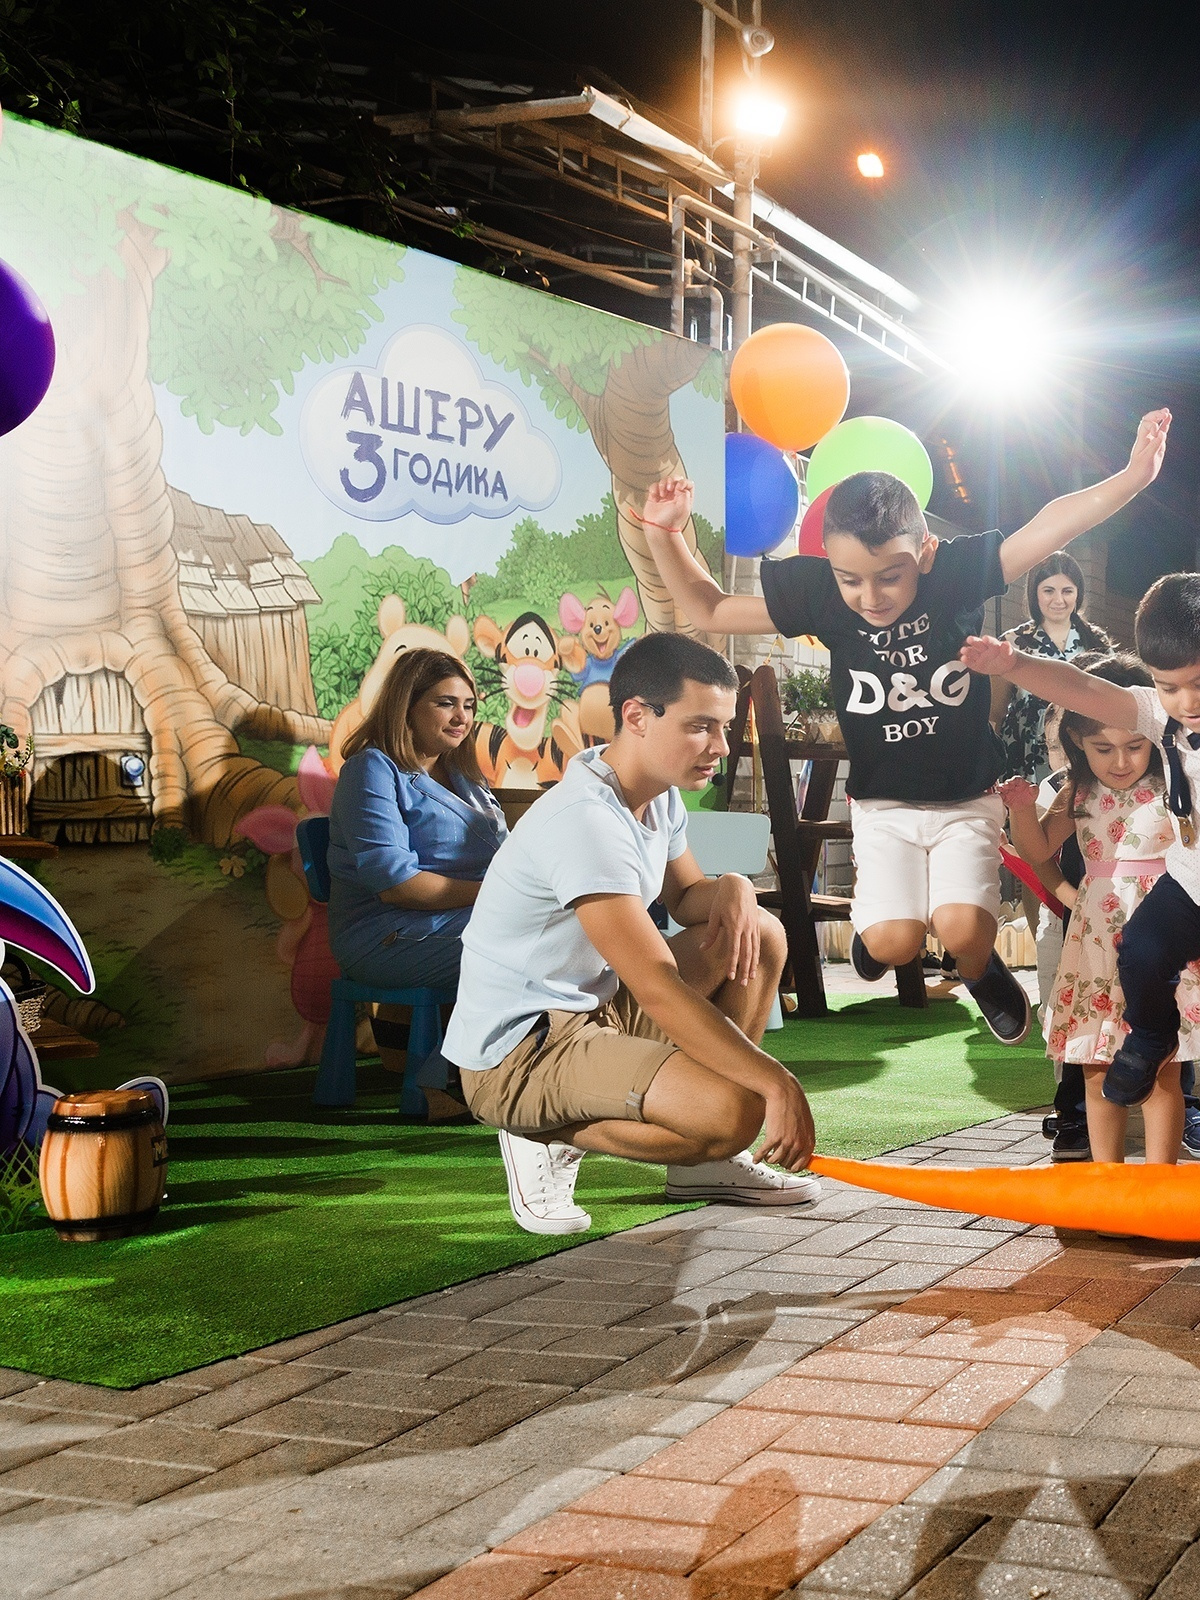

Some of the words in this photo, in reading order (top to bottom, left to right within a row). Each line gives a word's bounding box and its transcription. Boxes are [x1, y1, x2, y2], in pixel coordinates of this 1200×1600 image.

[341, 371, 515, 452] АШЕРУ
[339, 430, 387, 503] 3
[393, 447, 508, 502] ГОДИКА
[846, 660, 971, 715] D&G
[882, 716, 939, 743] BOY
